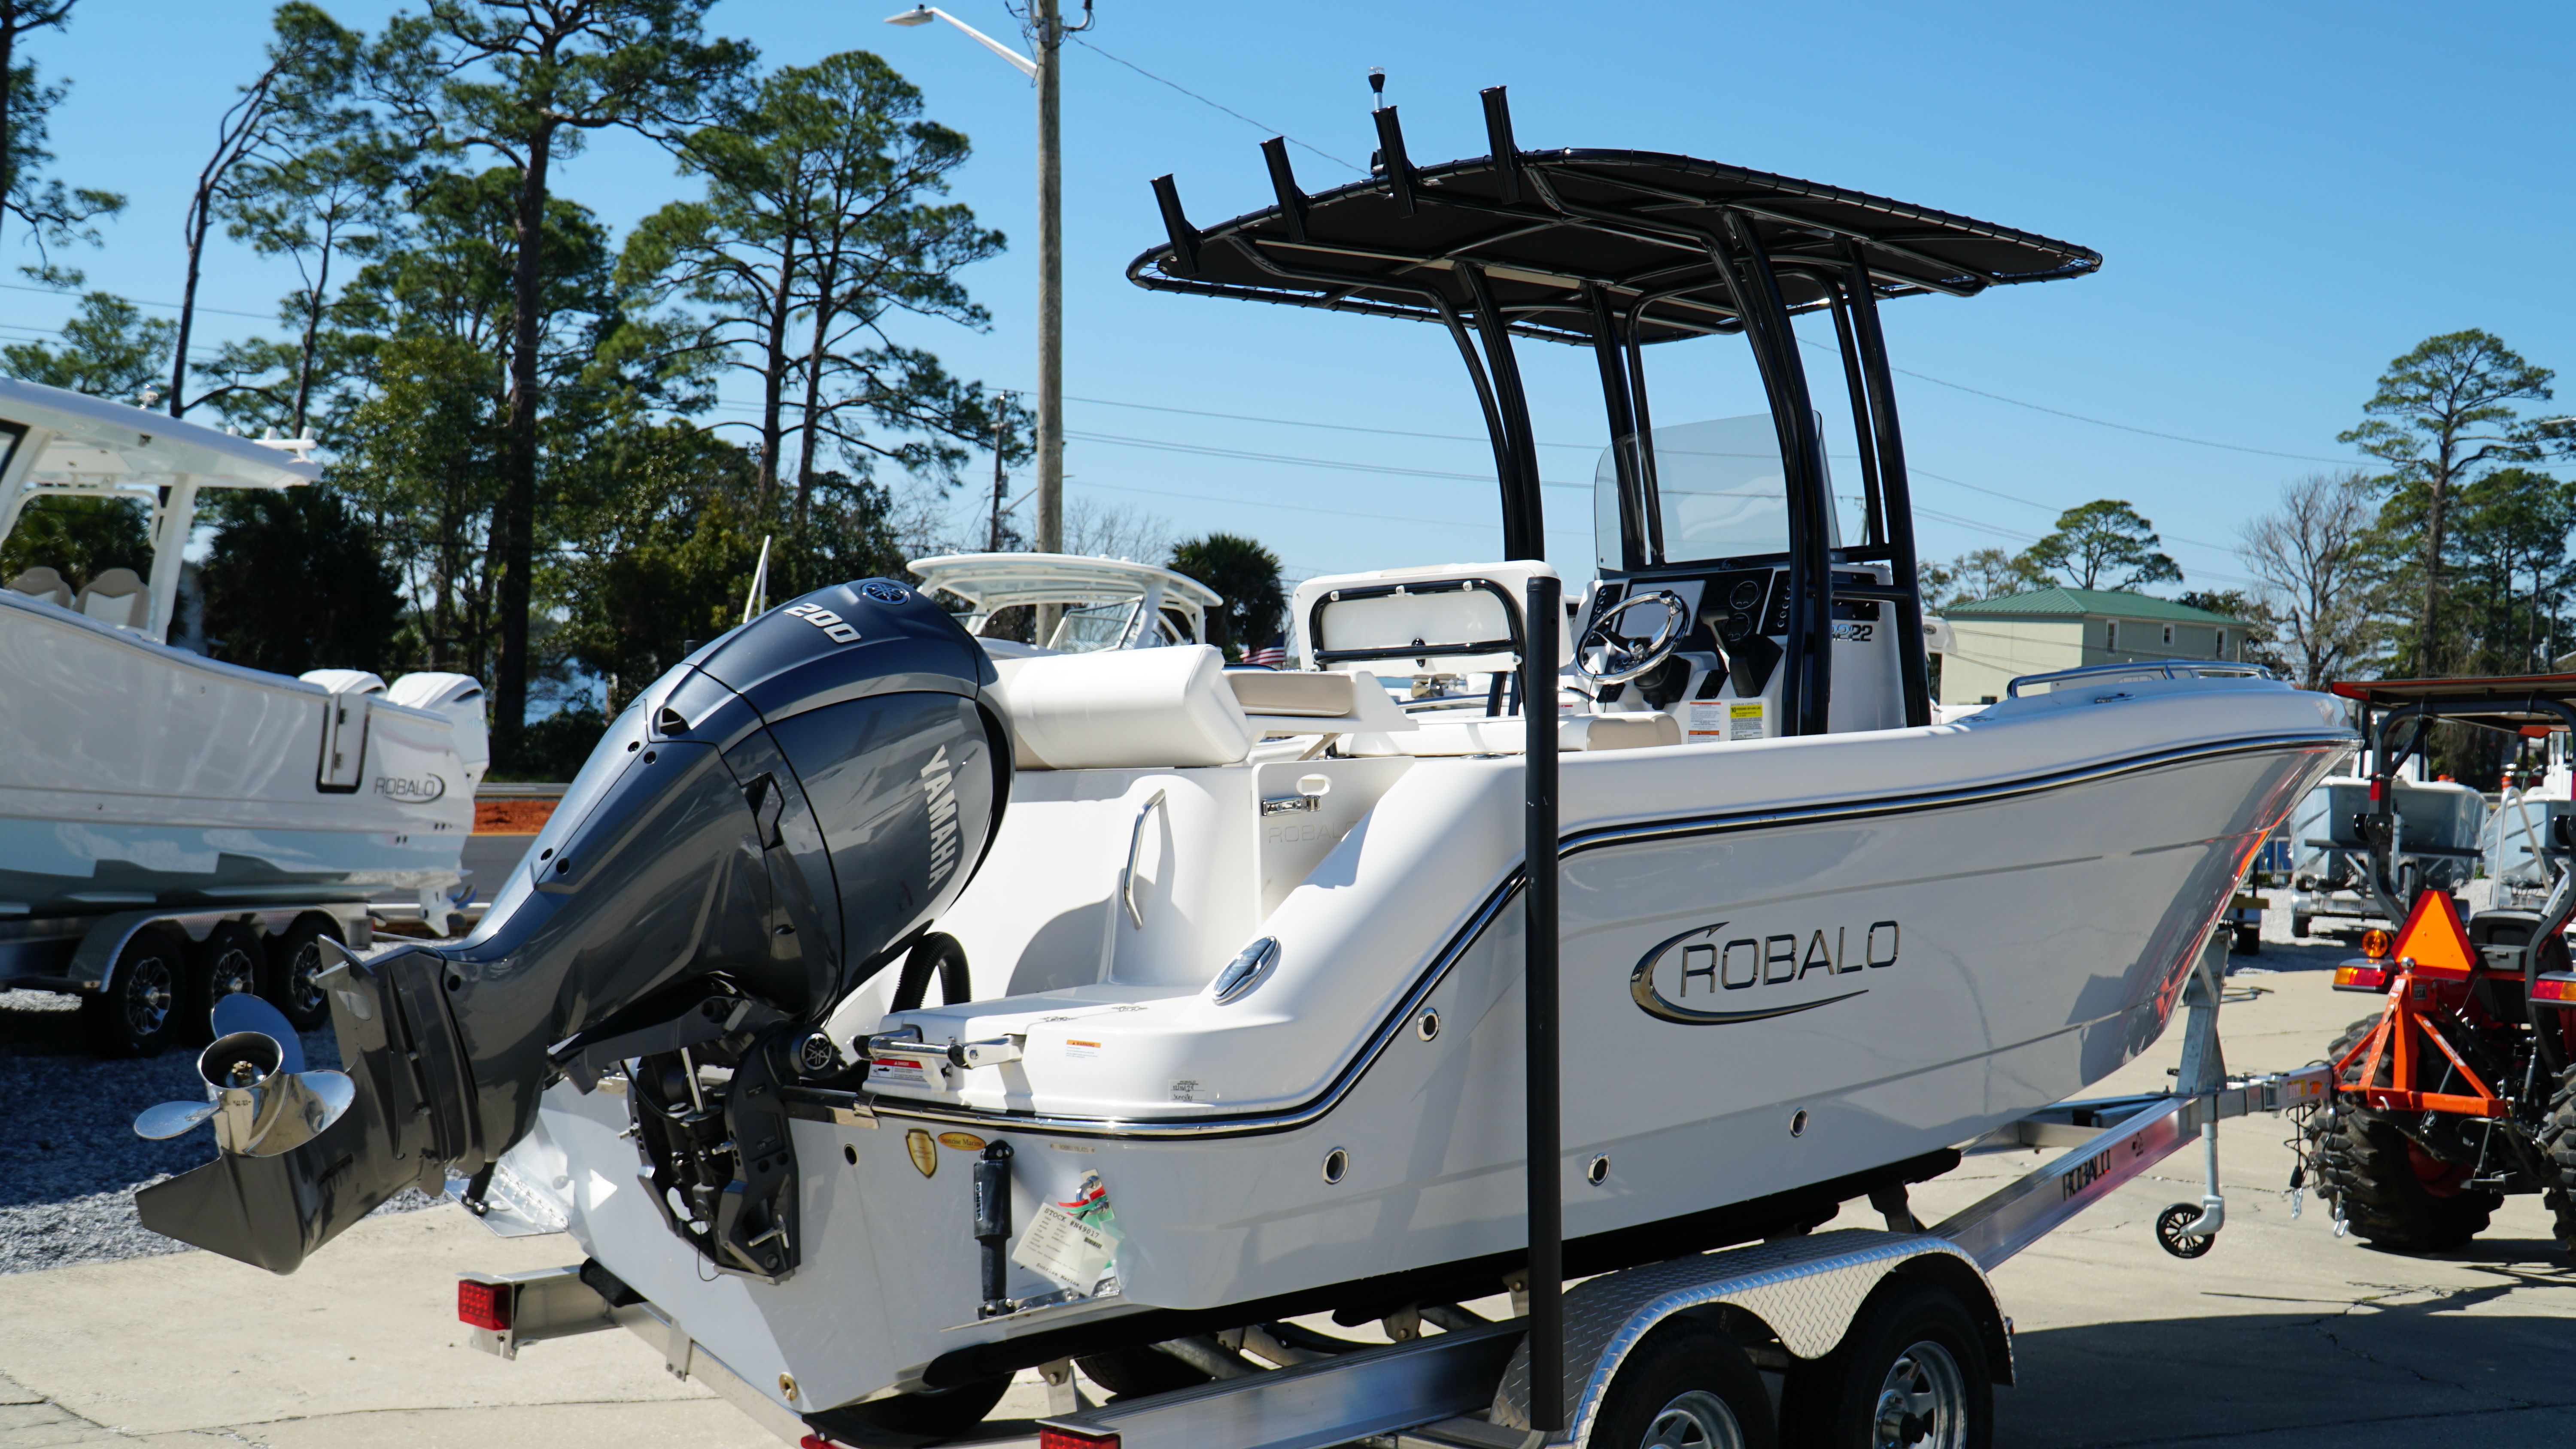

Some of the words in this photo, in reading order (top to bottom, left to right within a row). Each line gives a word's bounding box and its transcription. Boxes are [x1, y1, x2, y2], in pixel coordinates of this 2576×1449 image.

[782, 603, 861, 643] 200
[374, 776, 435, 797] ROBALO
[920, 744, 958, 891] YAMAHA
[1680, 920, 1899, 997] ROBALO
[2063, 1149, 2111, 1201] ROBALO
[1044, 1208, 1067, 1222] STOCK
[1069, 1220, 1100, 1238] #N49017
[1036, 1262, 1058, 1276] Sunrise
[1060, 1275, 1080, 1287] Marine
